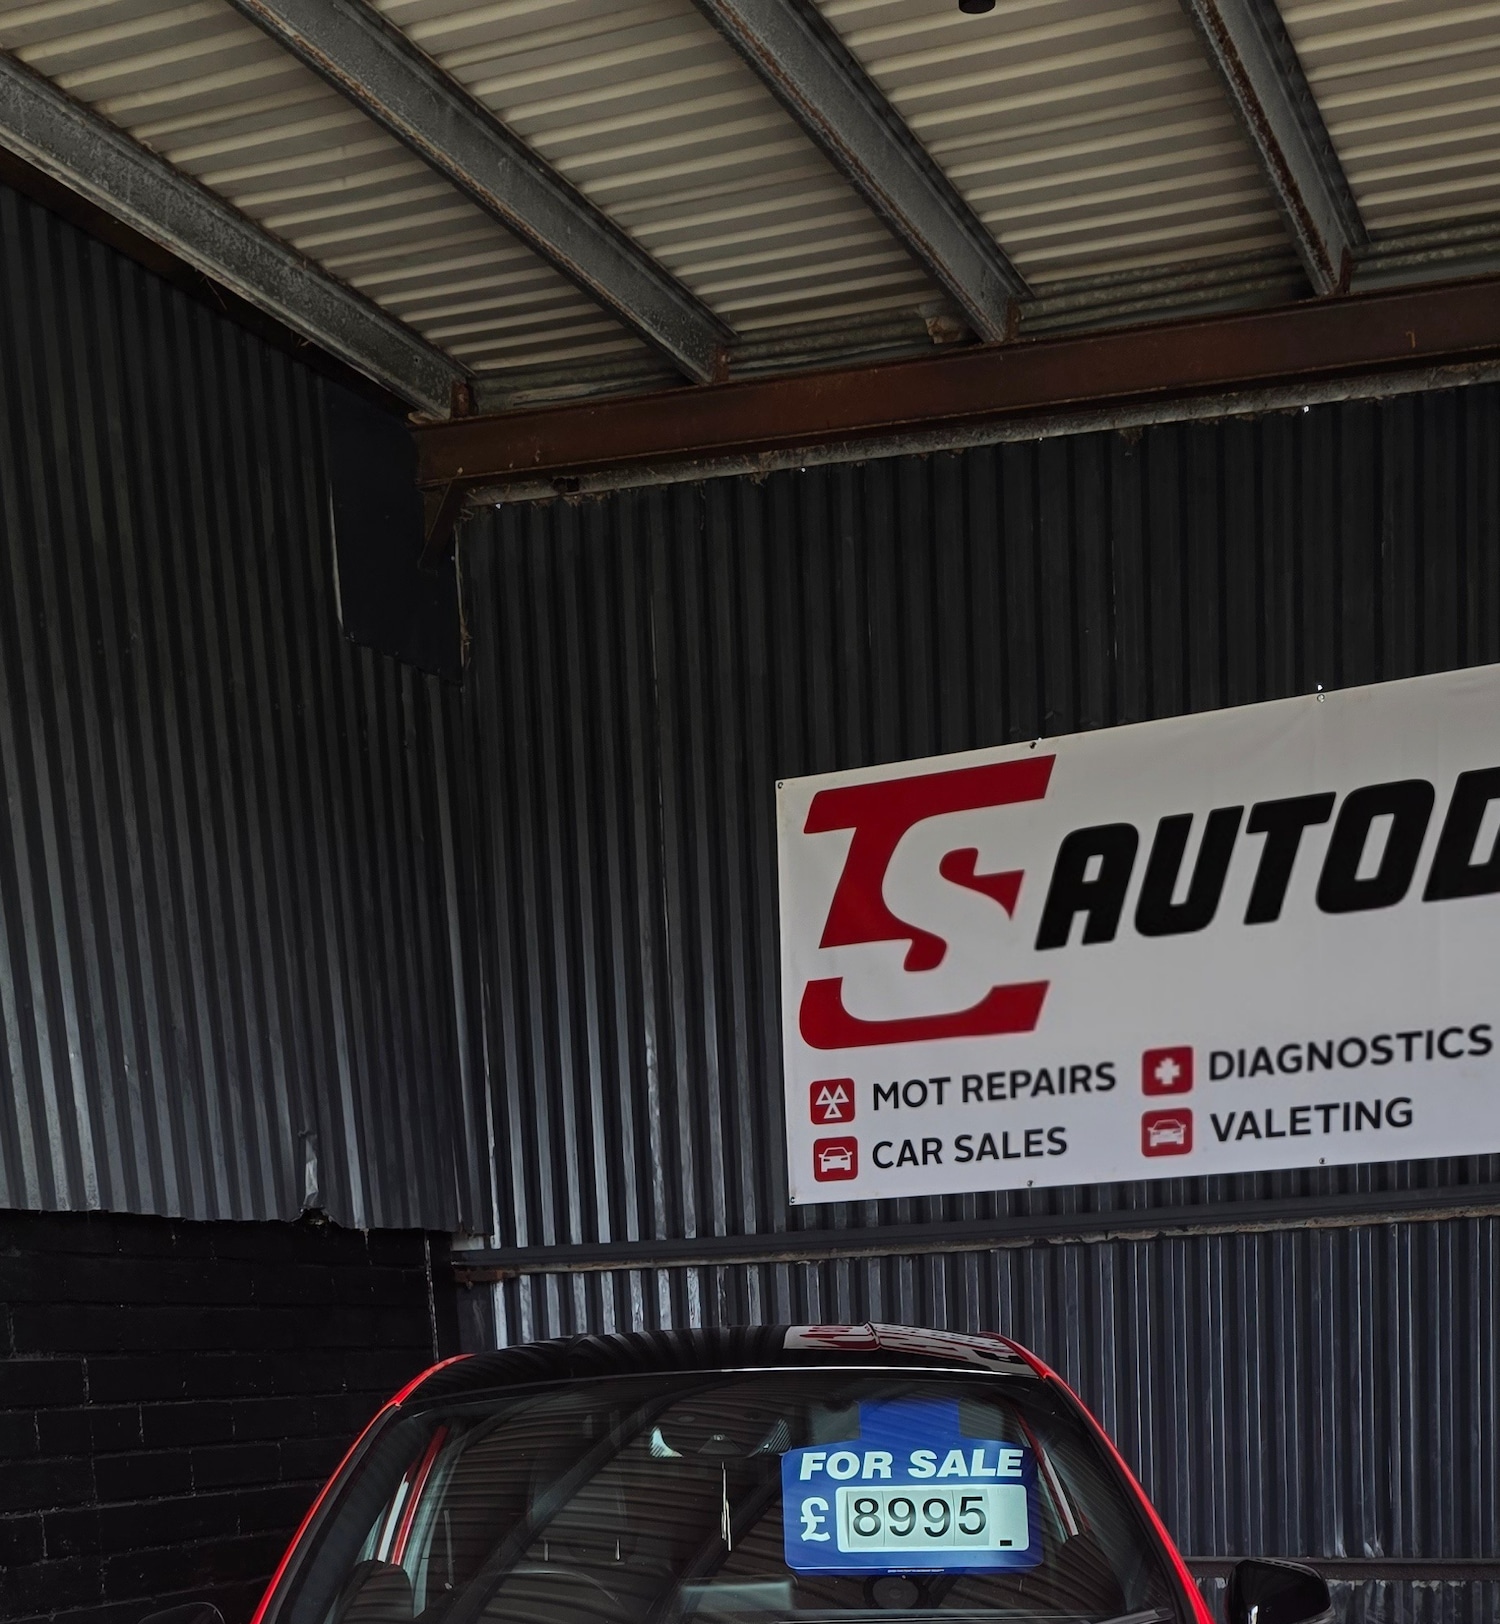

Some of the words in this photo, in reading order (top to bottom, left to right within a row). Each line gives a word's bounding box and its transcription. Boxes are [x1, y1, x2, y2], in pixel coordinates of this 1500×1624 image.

[799, 754, 1057, 1049] TS
[1034, 766, 1500, 951] AUTOD
[1209, 1023, 1493, 1082] DIAGNOSTICS
[871, 1077, 951, 1111] MOT
[961, 1062, 1117, 1103] REPAIRS
[1209, 1097, 1414, 1142] VALETING
[871, 1136, 943, 1169] CAR
[953, 1126, 1068, 1164] SALES
[799, 1450, 894, 1481] FOR
[907, 1448, 1024, 1478] SALE
[852, 1496, 987, 1538] 8995
